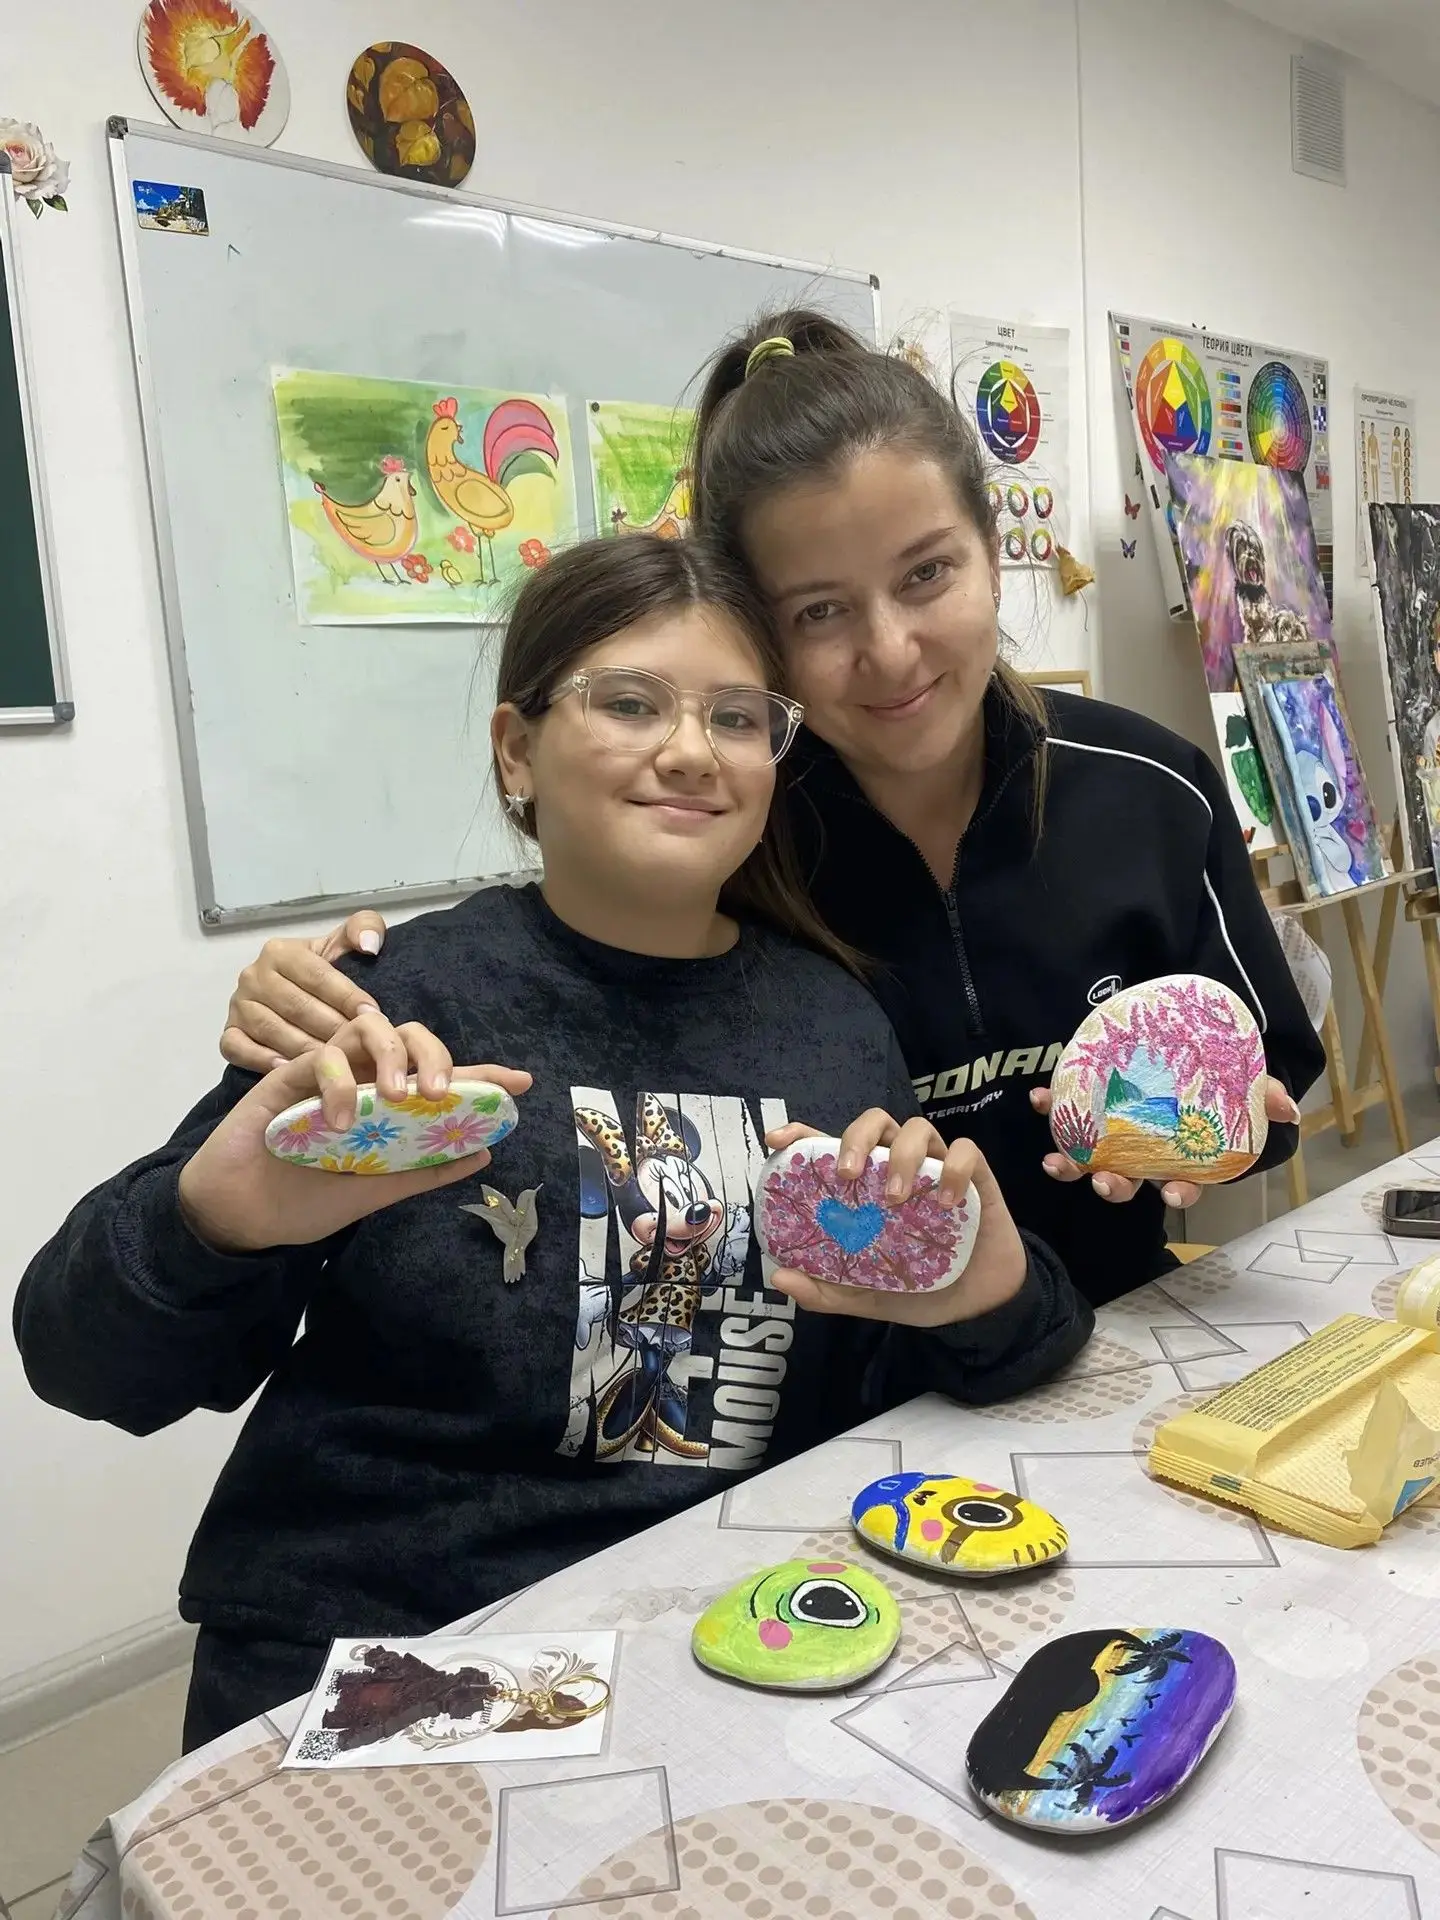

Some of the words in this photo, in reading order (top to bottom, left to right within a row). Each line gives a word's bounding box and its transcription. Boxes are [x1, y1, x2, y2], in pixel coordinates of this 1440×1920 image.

[997, 325, 1015, 338] ЦВЕТ
[1202, 336, 1229, 353] ТЕОРИЯ
[1231, 341, 1253, 358] ЦВЕТА
[926, 1089, 1003, 1120] TERRITRY
[709, 1287, 795, 1470] MOUSE
